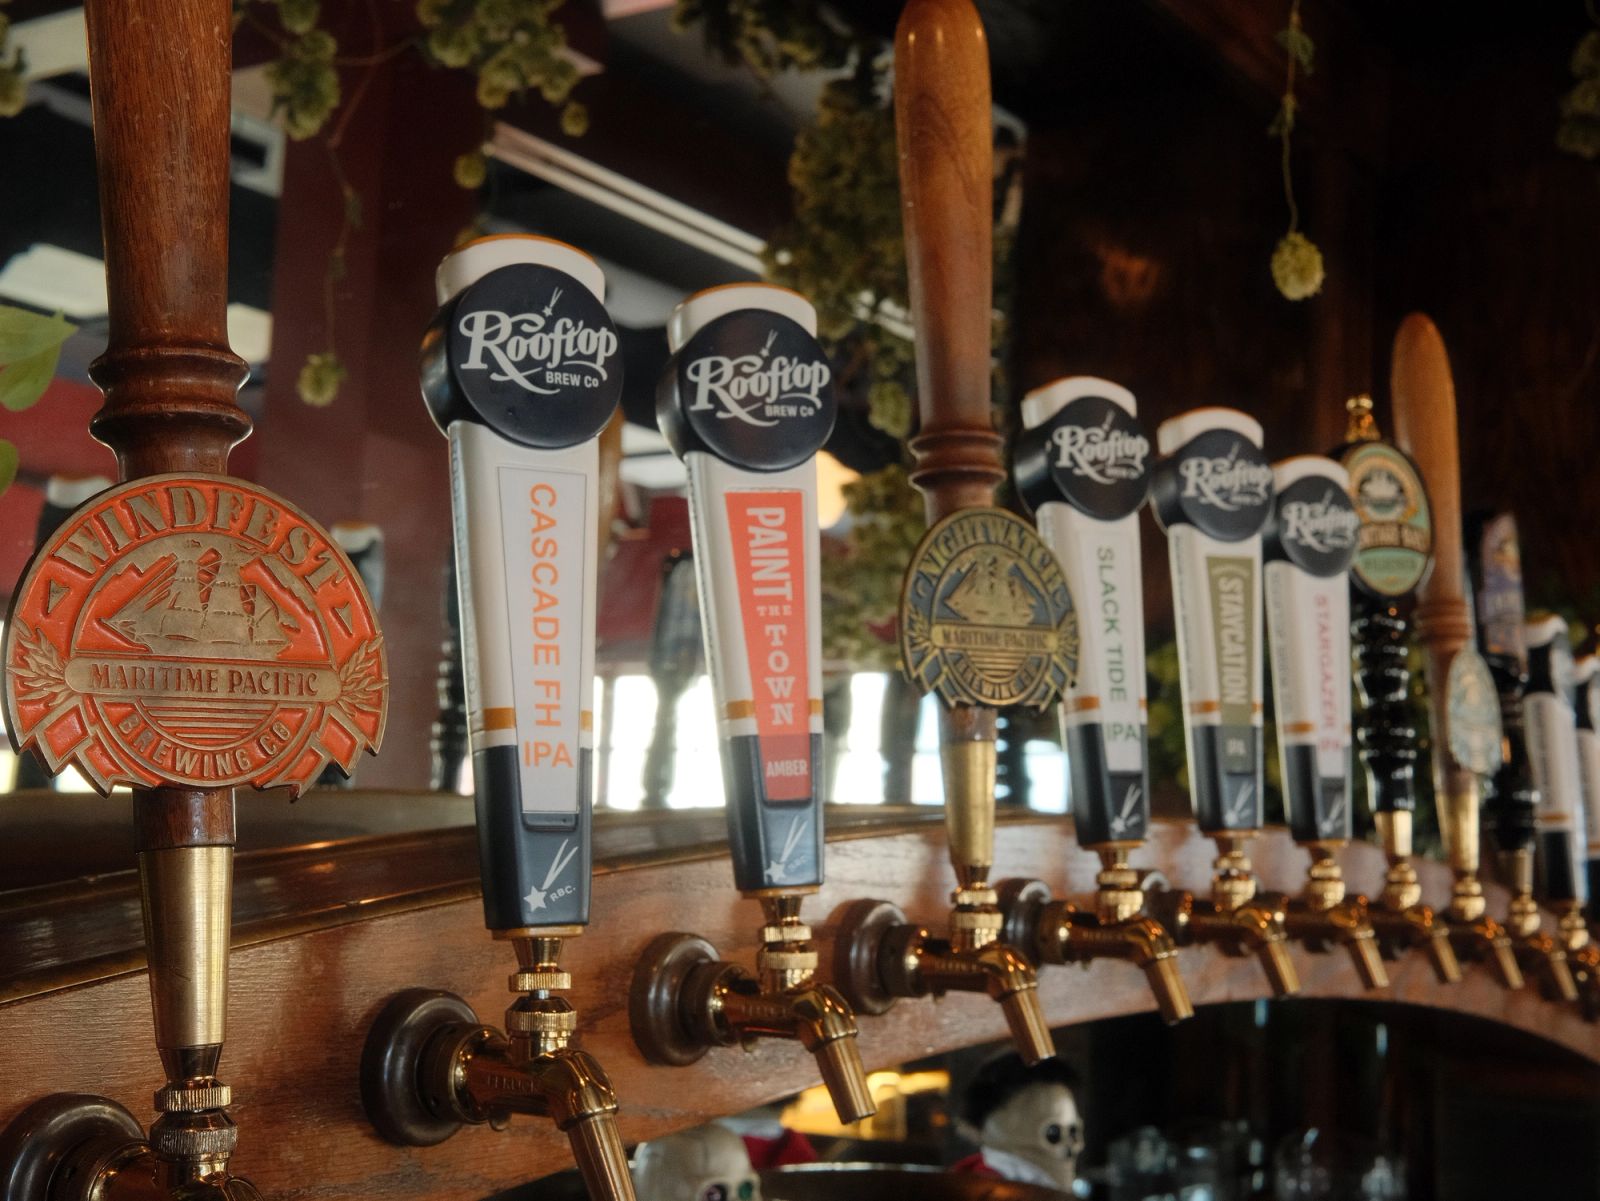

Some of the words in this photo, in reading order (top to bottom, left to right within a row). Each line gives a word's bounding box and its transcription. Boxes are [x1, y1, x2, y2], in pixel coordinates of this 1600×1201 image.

[459, 310, 618, 395] Rooftop
[546, 370, 580, 387] BREW
[686, 354, 831, 427] Rooftop
[764, 404, 796, 417] BREW
[1053, 425, 1149, 485] Rooftop
[53, 486, 348, 592] WINDFEST
[746, 507, 793, 601] PAINT
[529, 483, 561, 667] CASCADE
[1097, 547, 1120, 634] SLACK
[757, 605, 792, 617] THE
[1218, 575, 1249, 705] STAYCATION
[89, 663, 219, 694] MARITIME
[227, 667, 320, 696] PACIFIC
[534, 679, 561, 728] FH
[764, 623, 796, 726] TOWN
[1107, 645, 1128, 703] TIDE
[118, 711, 250, 777] BREWING
[523, 741, 574, 769] IPA
[1106, 722, 1141, 742] IPA
[766, 759, 808, 778] AMBER
